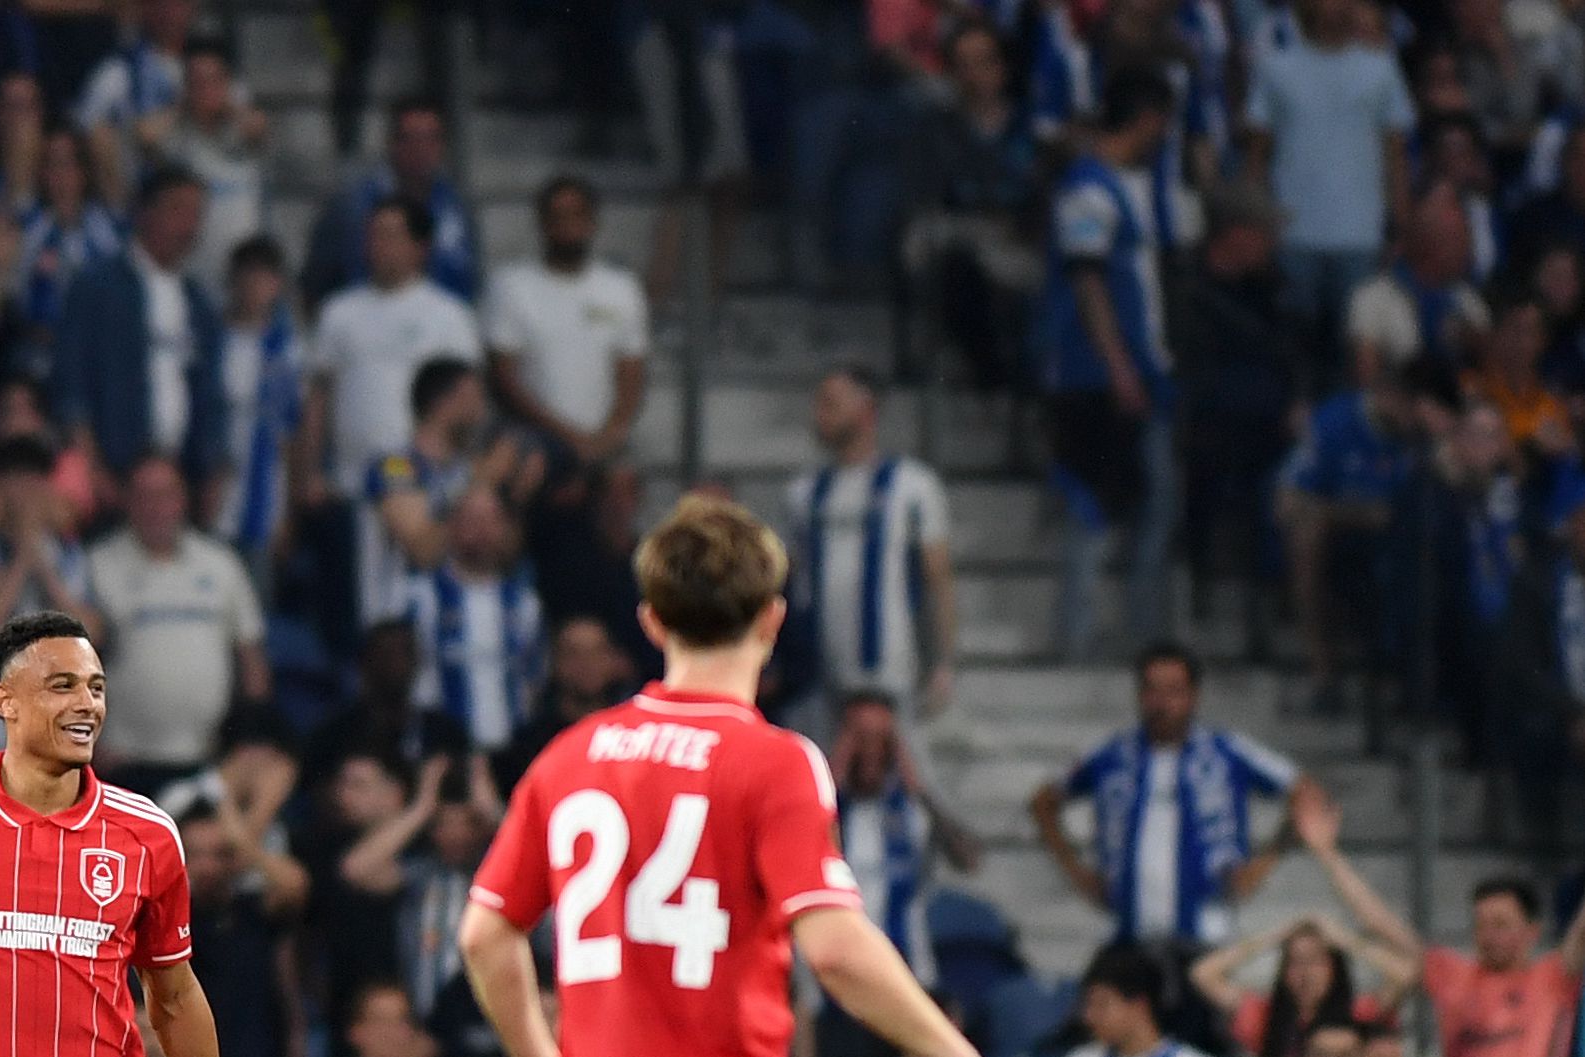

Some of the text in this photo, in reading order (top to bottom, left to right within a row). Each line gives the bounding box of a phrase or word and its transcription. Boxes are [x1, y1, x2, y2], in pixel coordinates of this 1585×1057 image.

[547, 788, 731, 990] 24
[67, 917, 115, 942] FOREST
[60, 936, 100, 958] TRUST
